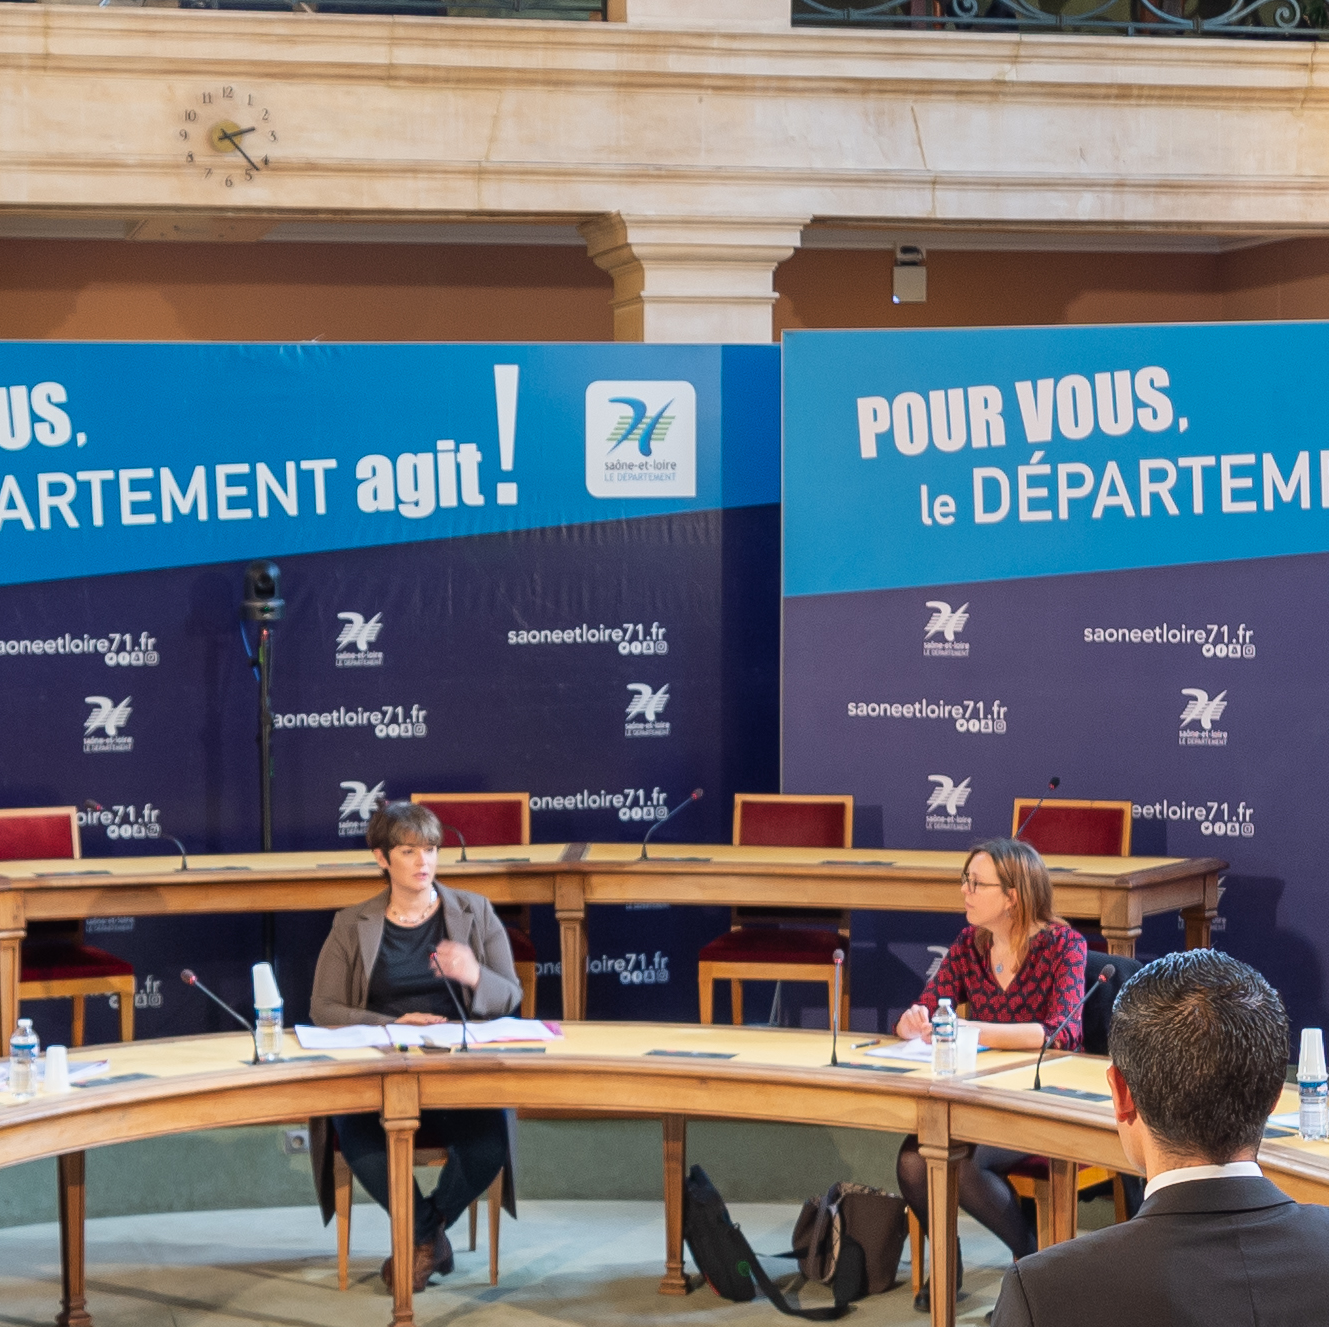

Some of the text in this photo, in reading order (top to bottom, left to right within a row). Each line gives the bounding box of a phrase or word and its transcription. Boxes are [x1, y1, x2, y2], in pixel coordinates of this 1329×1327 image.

[222, 86, 233, 98] 12
[185, 110, 197, 122] 10
[262, 108, 269, 120] 2
[179, 129, 187, 141] 9
[225, 174, 233, 188] 6
[245, 168, 253, 181] 5
[857, 365, 1188, 459] POUR VOUS,
[604, 459, 677, 471] saône-et-loire
[920, 484, 956, 526] le
[507, 621, 667, 645] saoneetloire71.fr
[1083, 623, 1254, 644] saoneetloire71.fr
[274, 704, 428, 729] aoneetloire71.fr
[847, 698, 1008, 719] saoneetloire71.fr
[529, 787, 668, 811] oneetloire71.fr
[76, 803, 161, 827] oire71.fr
[1132, 799, 1254, 821] eetloire71.fr
